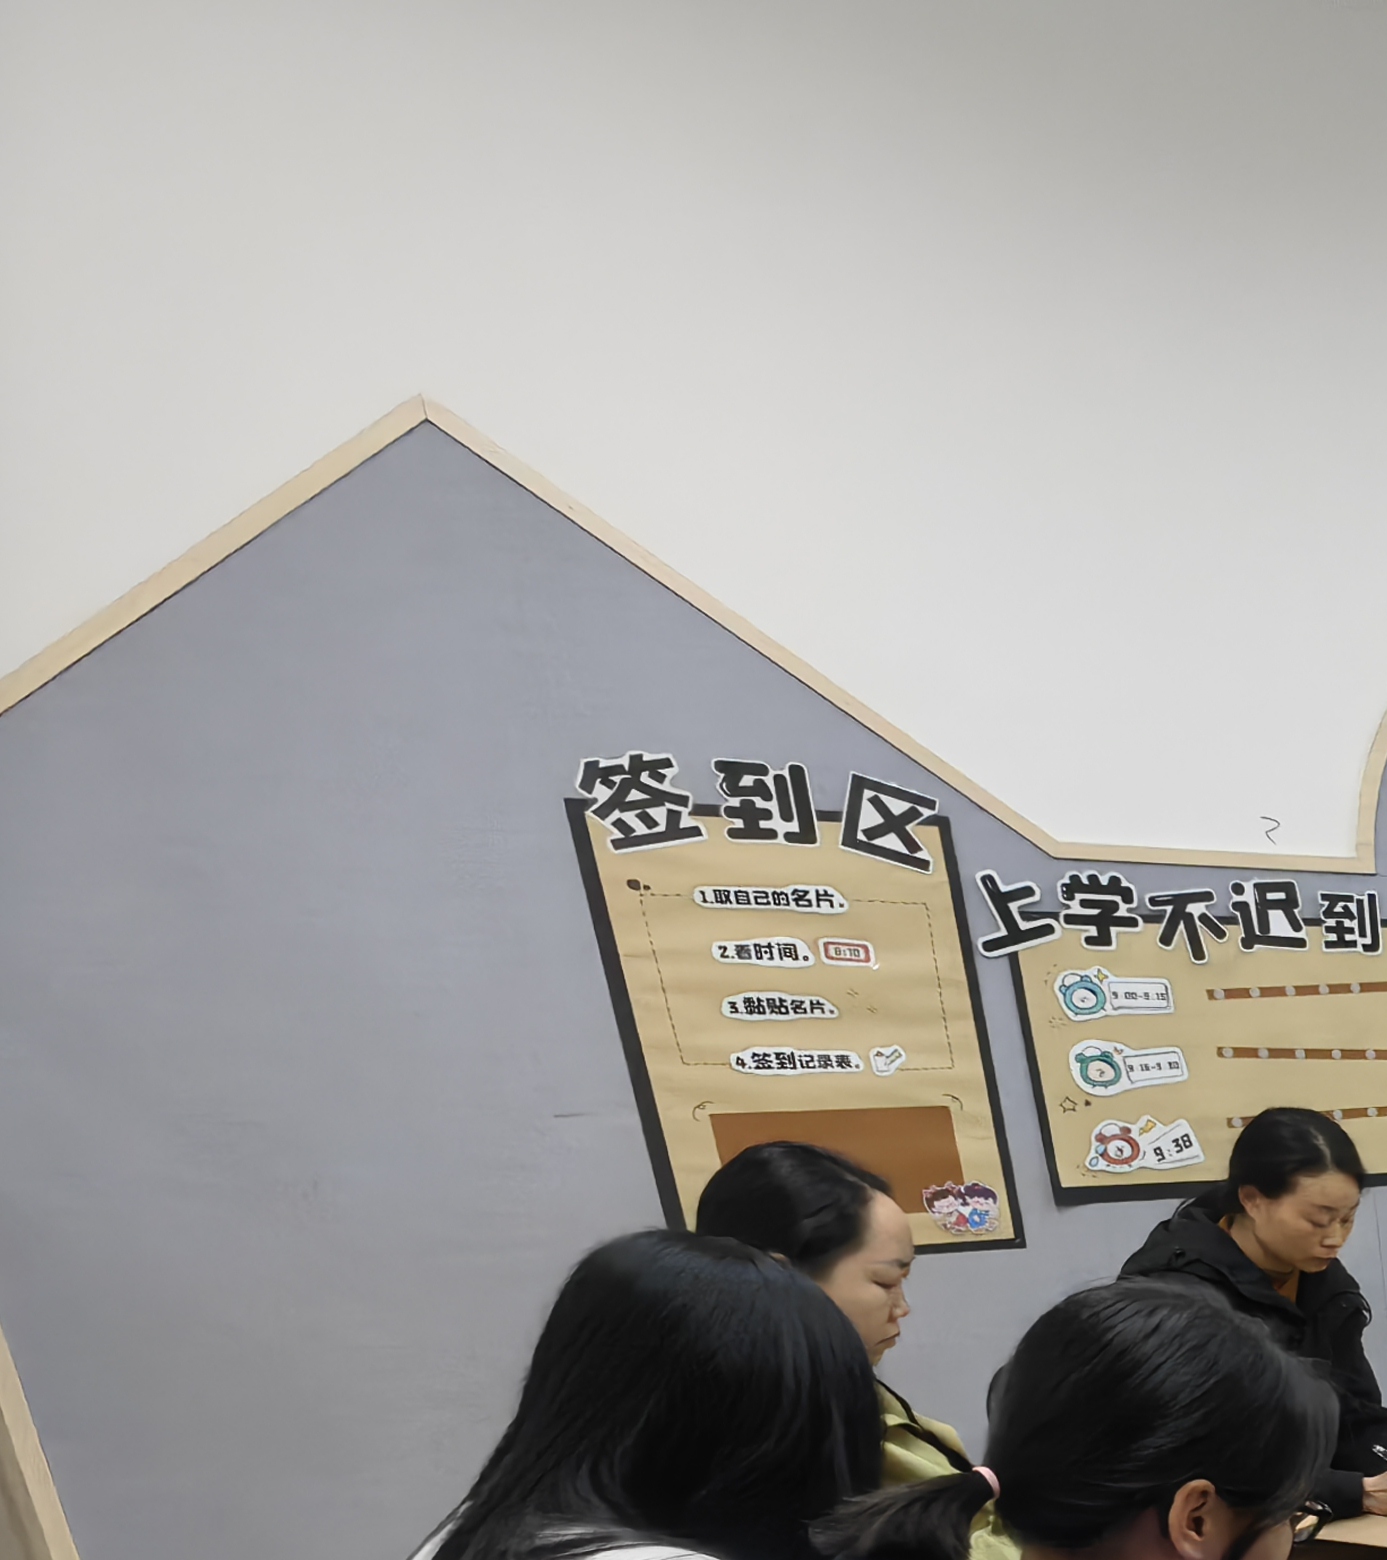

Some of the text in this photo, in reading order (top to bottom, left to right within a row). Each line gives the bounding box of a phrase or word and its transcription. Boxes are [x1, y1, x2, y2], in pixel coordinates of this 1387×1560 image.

[578, 753, 938, 872] 签到区
[978, 872, 1381, 962] 上学不迟到
[718, 942, 810, 962] 2.看时间。
[1153, 1133, 1194, 1162] 9:38
